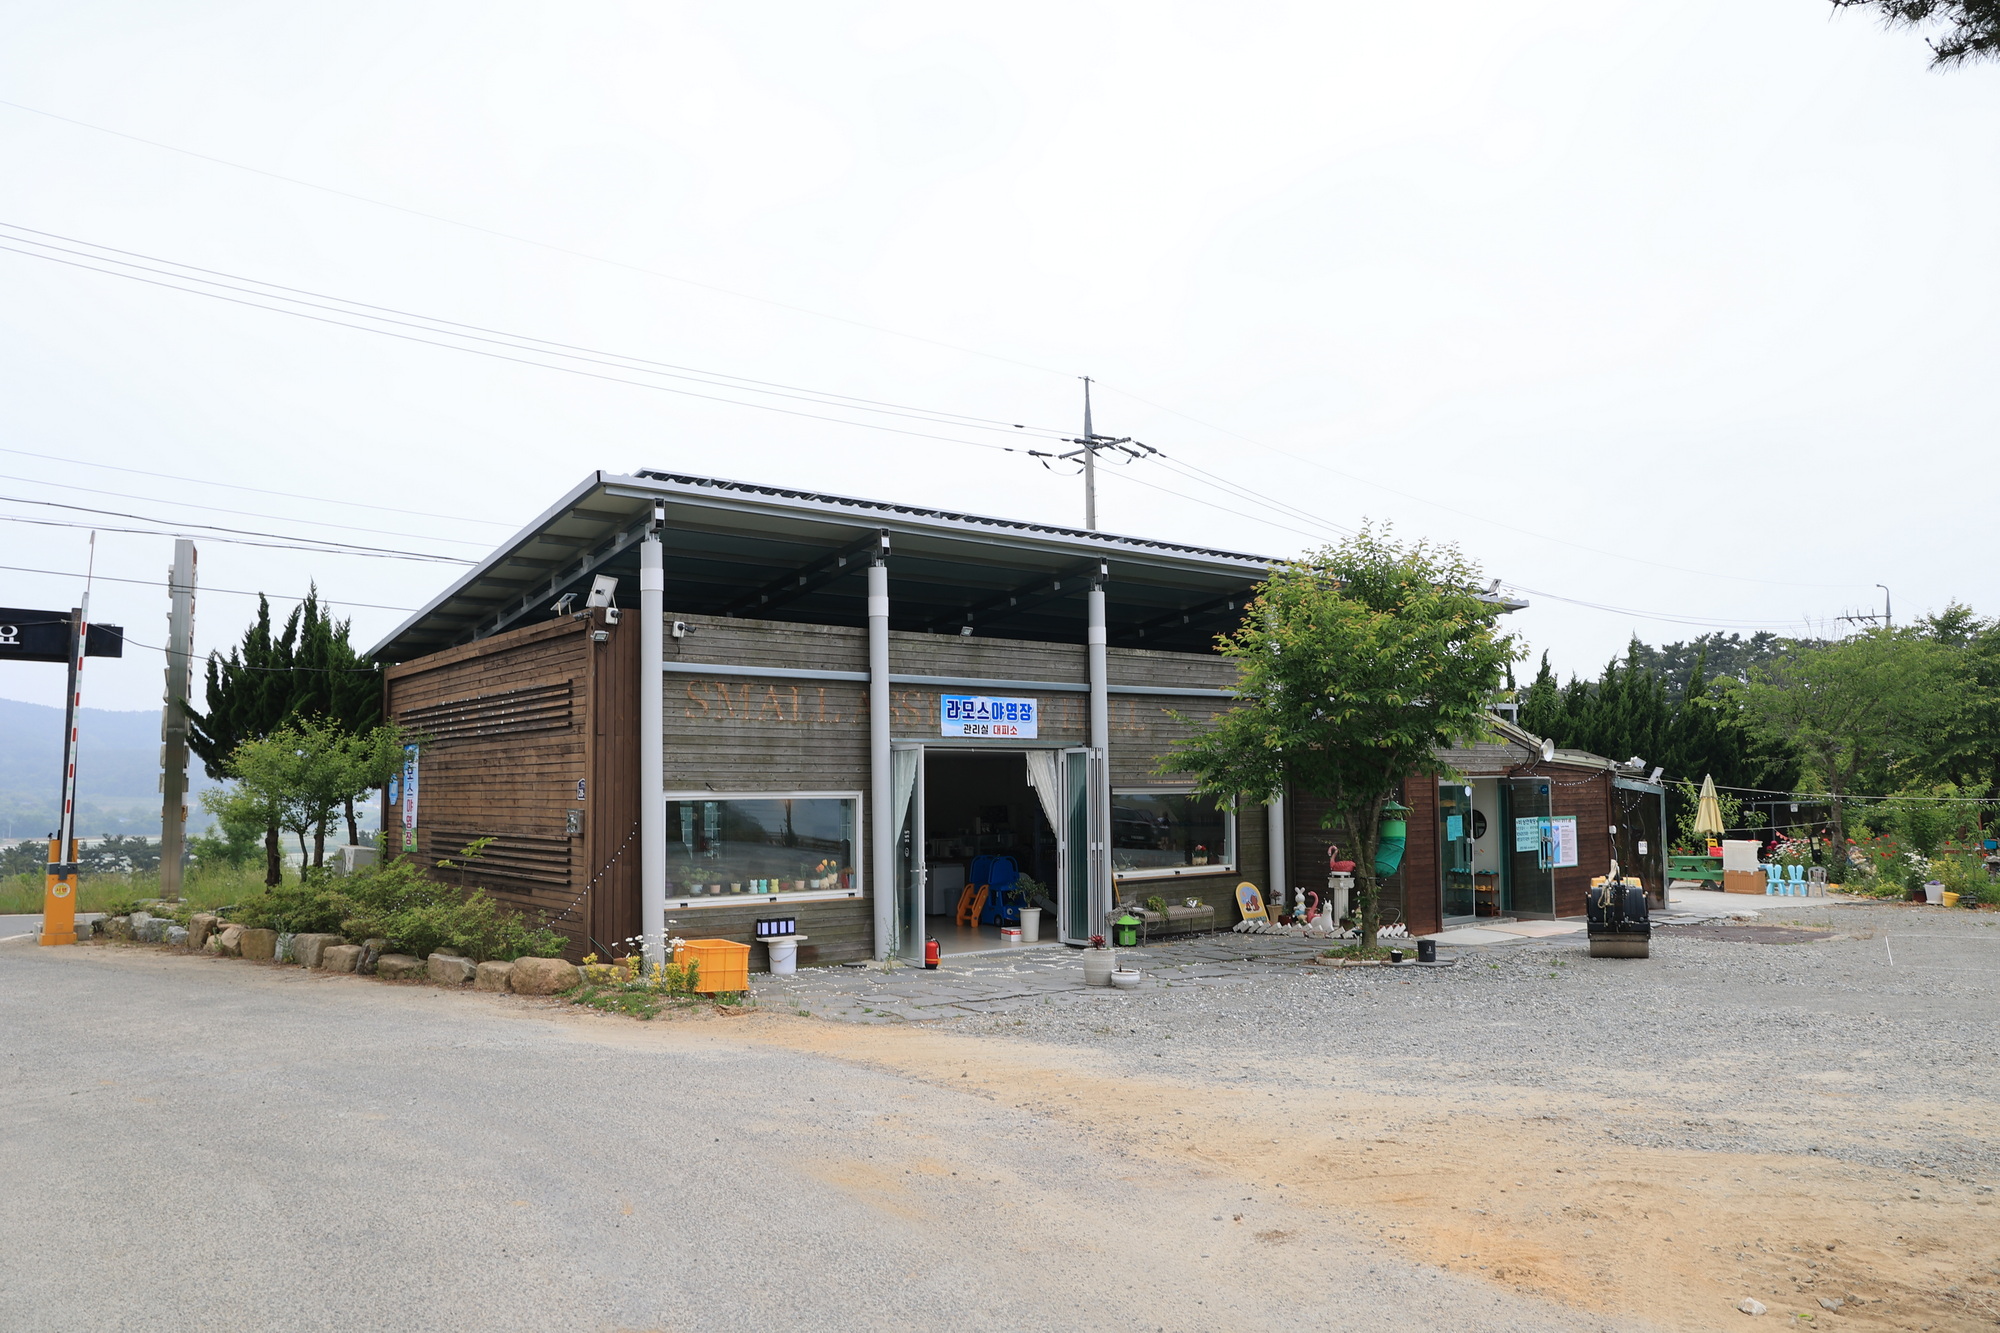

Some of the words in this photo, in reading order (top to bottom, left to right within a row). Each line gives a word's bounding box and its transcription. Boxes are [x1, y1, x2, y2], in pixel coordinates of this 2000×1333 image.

[0, 625, 20, 644] 요
[946, 700, 1032, 721] 라모스야영장
[963, 724, 988, 735] 관리실
[993, 725, 1018, 735] 대피소
